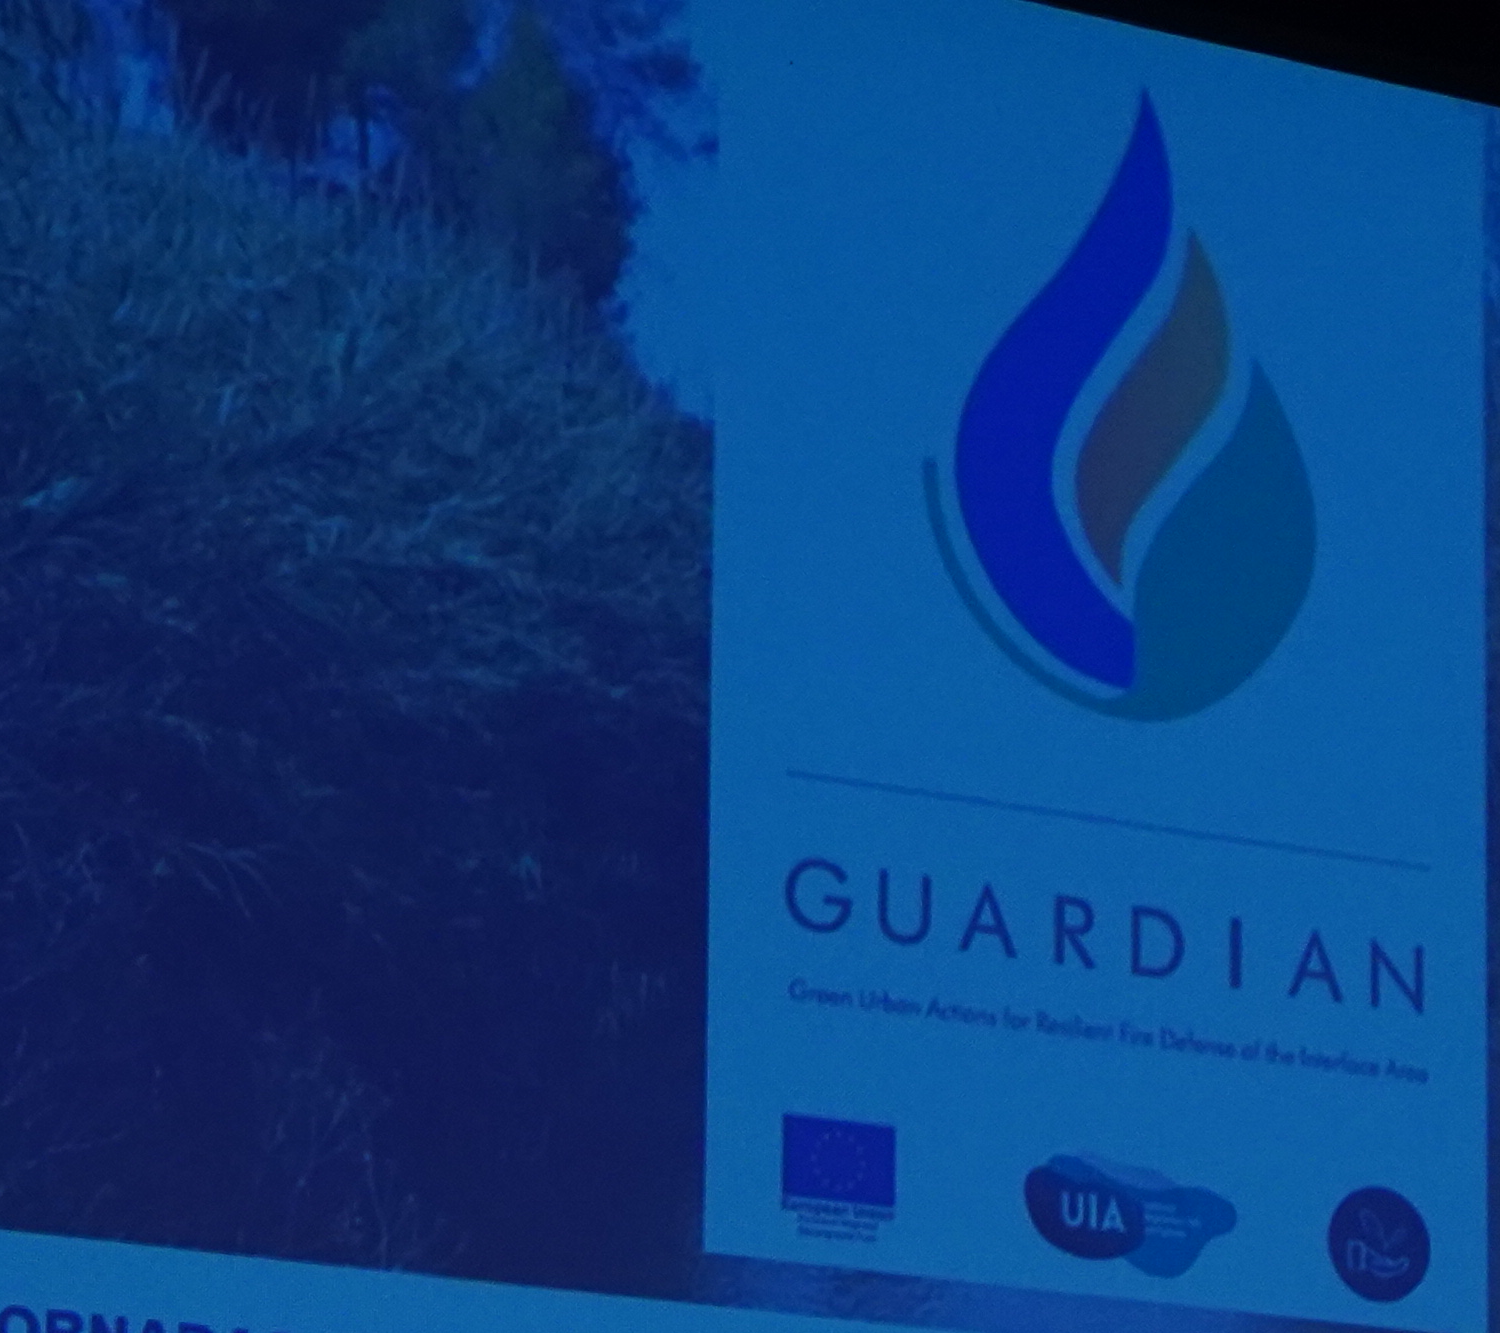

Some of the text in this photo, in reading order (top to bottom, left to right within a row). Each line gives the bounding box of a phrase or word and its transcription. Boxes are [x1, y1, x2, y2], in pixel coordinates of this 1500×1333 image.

[783, 856, 1427, 1016] GUARDIAN
[859, 988, 921, 1015] Urban
[924, 998, 997, 1027] Actions
[1060, 1191, 1125, 1234] UIA
